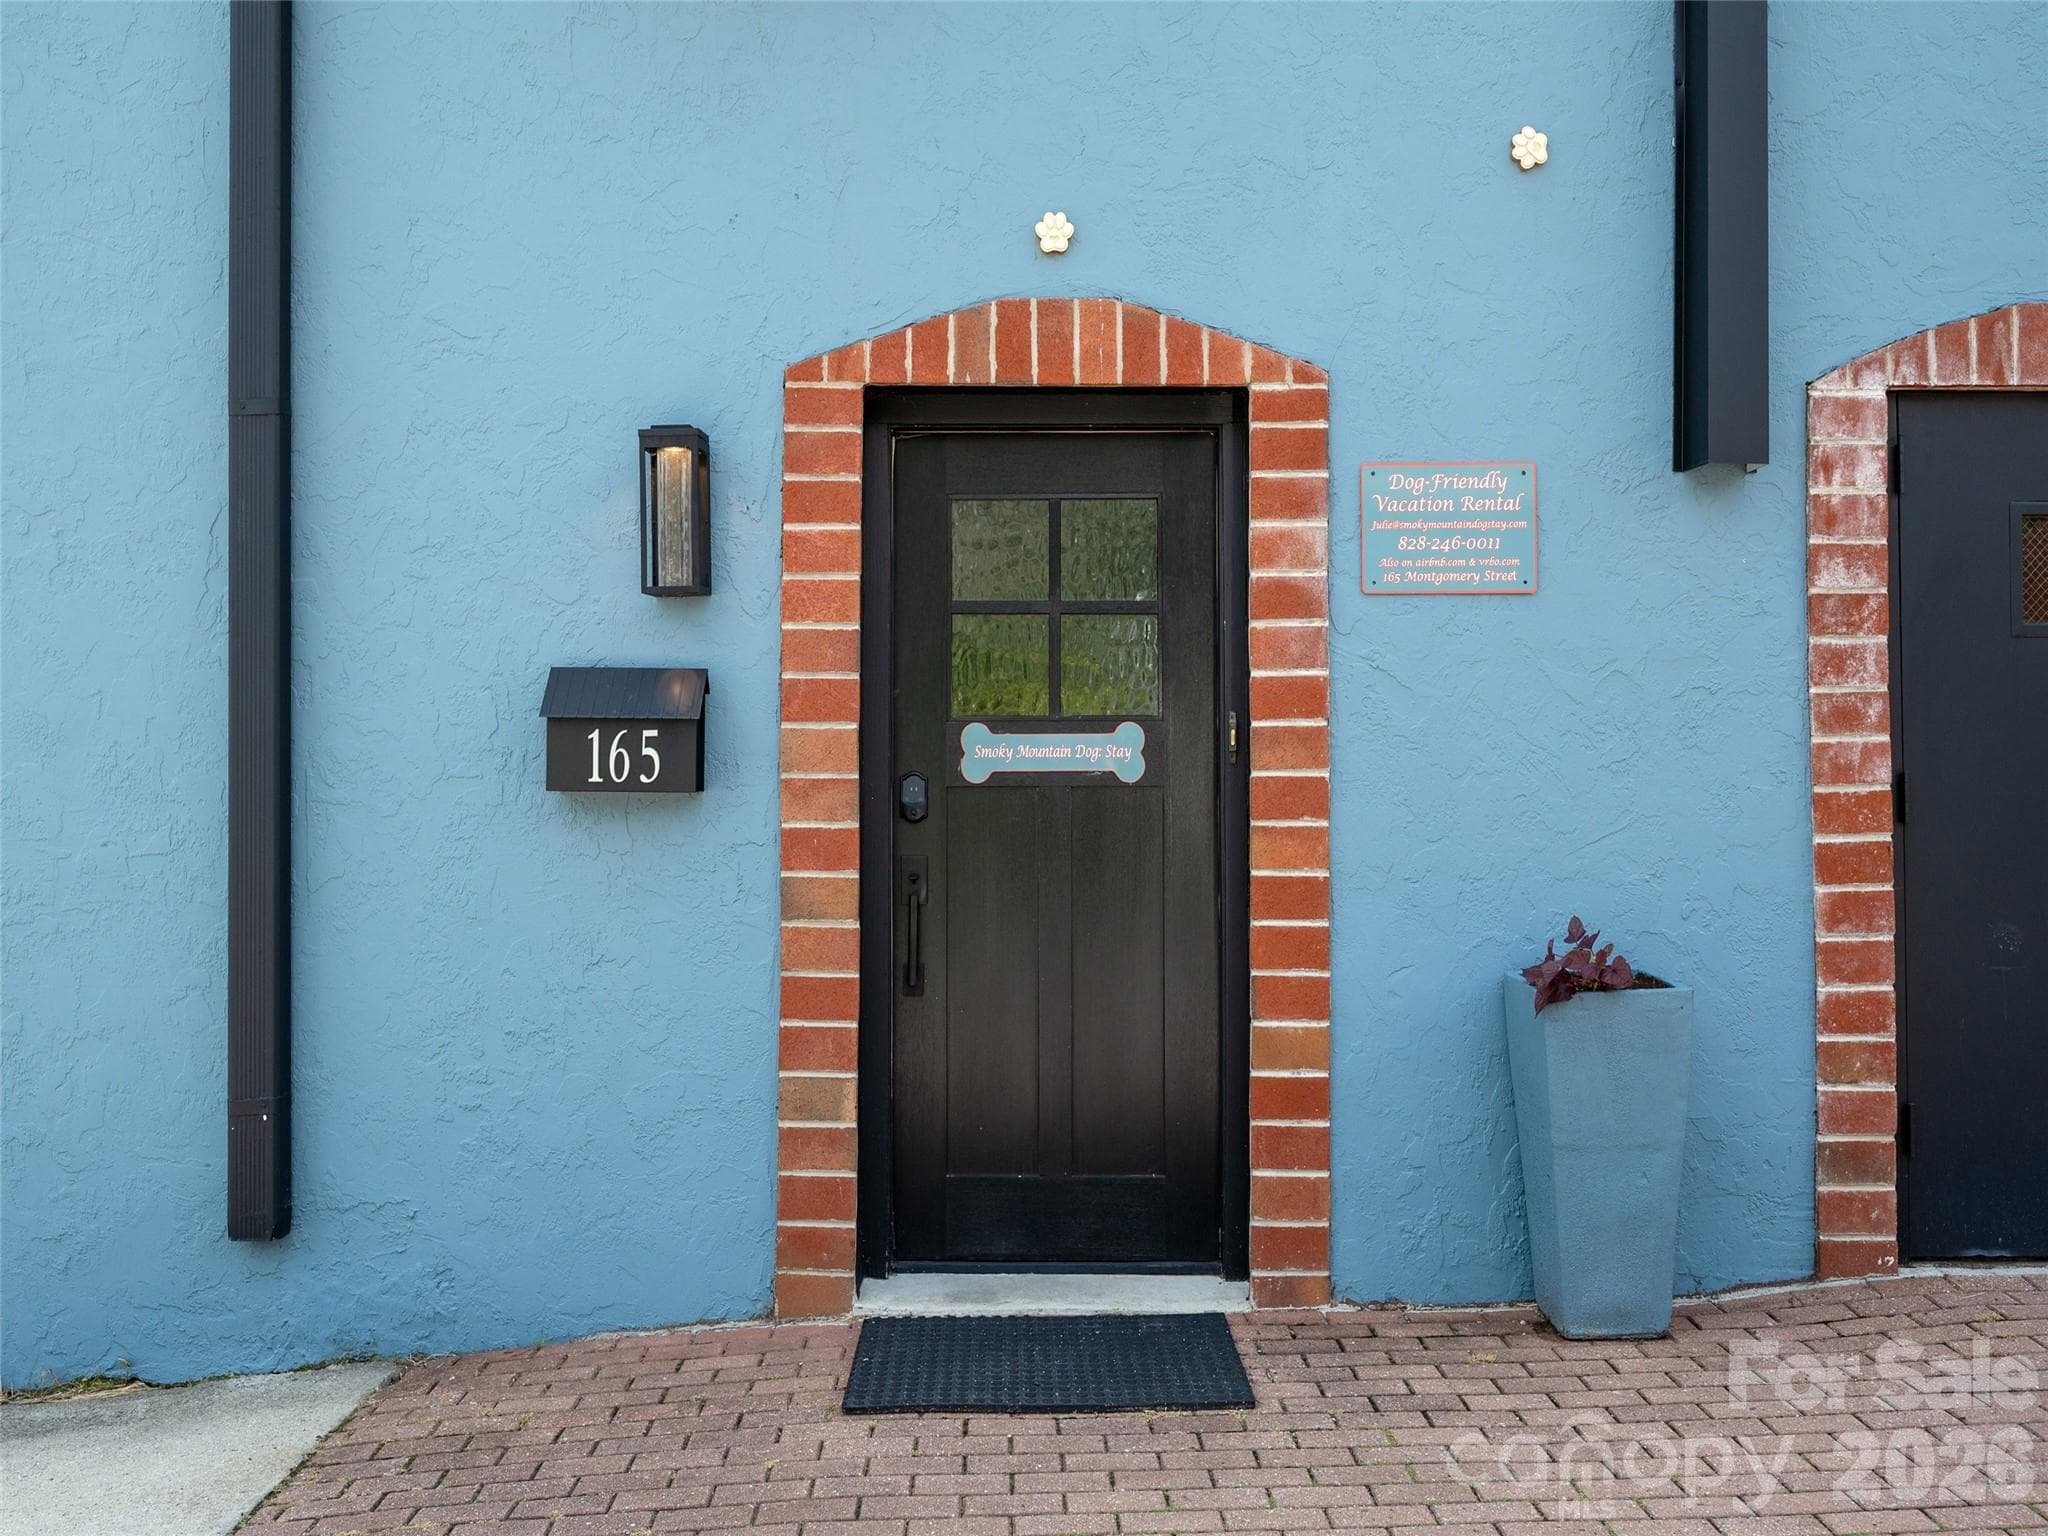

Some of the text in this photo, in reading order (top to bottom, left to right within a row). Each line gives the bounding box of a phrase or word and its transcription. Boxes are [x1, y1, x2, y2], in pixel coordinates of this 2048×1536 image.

[1388, 470, 1507, 495] Dog-Friendly
[1372, 493, 1525, 512] Vacation Rental
[1398, 536, 1501, 552] 828-246-0011
[1378, 556, 1520, 567] Also on airbnb.com & vrbo.com
[1383, 569, 1517, 585] 165 Montgomery Street
[587, 728, 661, 783] 165
[974, 743, 1013, 763] Smoky
[1016, 744, 1072, 758] Mountain
[1105, 744, 1132, 762] Stay
